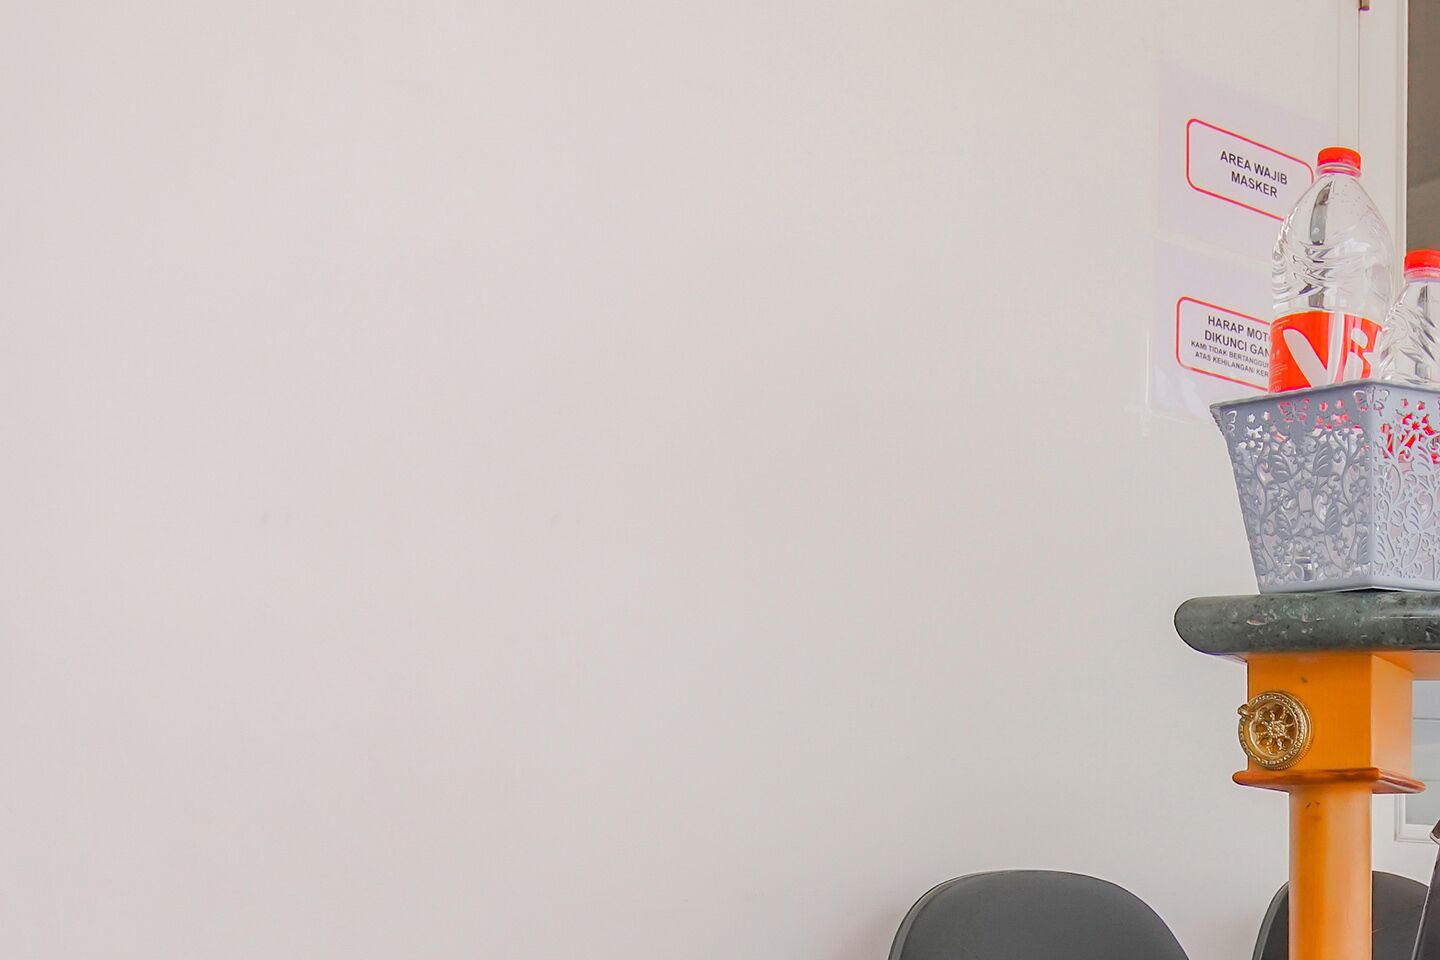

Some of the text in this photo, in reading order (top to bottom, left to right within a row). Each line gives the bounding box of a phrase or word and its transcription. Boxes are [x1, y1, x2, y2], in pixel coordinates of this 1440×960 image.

[1220, 151, 1288, 185] AREA WAJIB
[1231, 171, 1278, 198] MASKER
[1208, 315, 1270, 342] HARAP MOT
[1191, 340, 1207, 350] KAMI
[1204, 330, 1247, 352] DIKUNCI
[1195, 351, 1211, 361] ATAS
